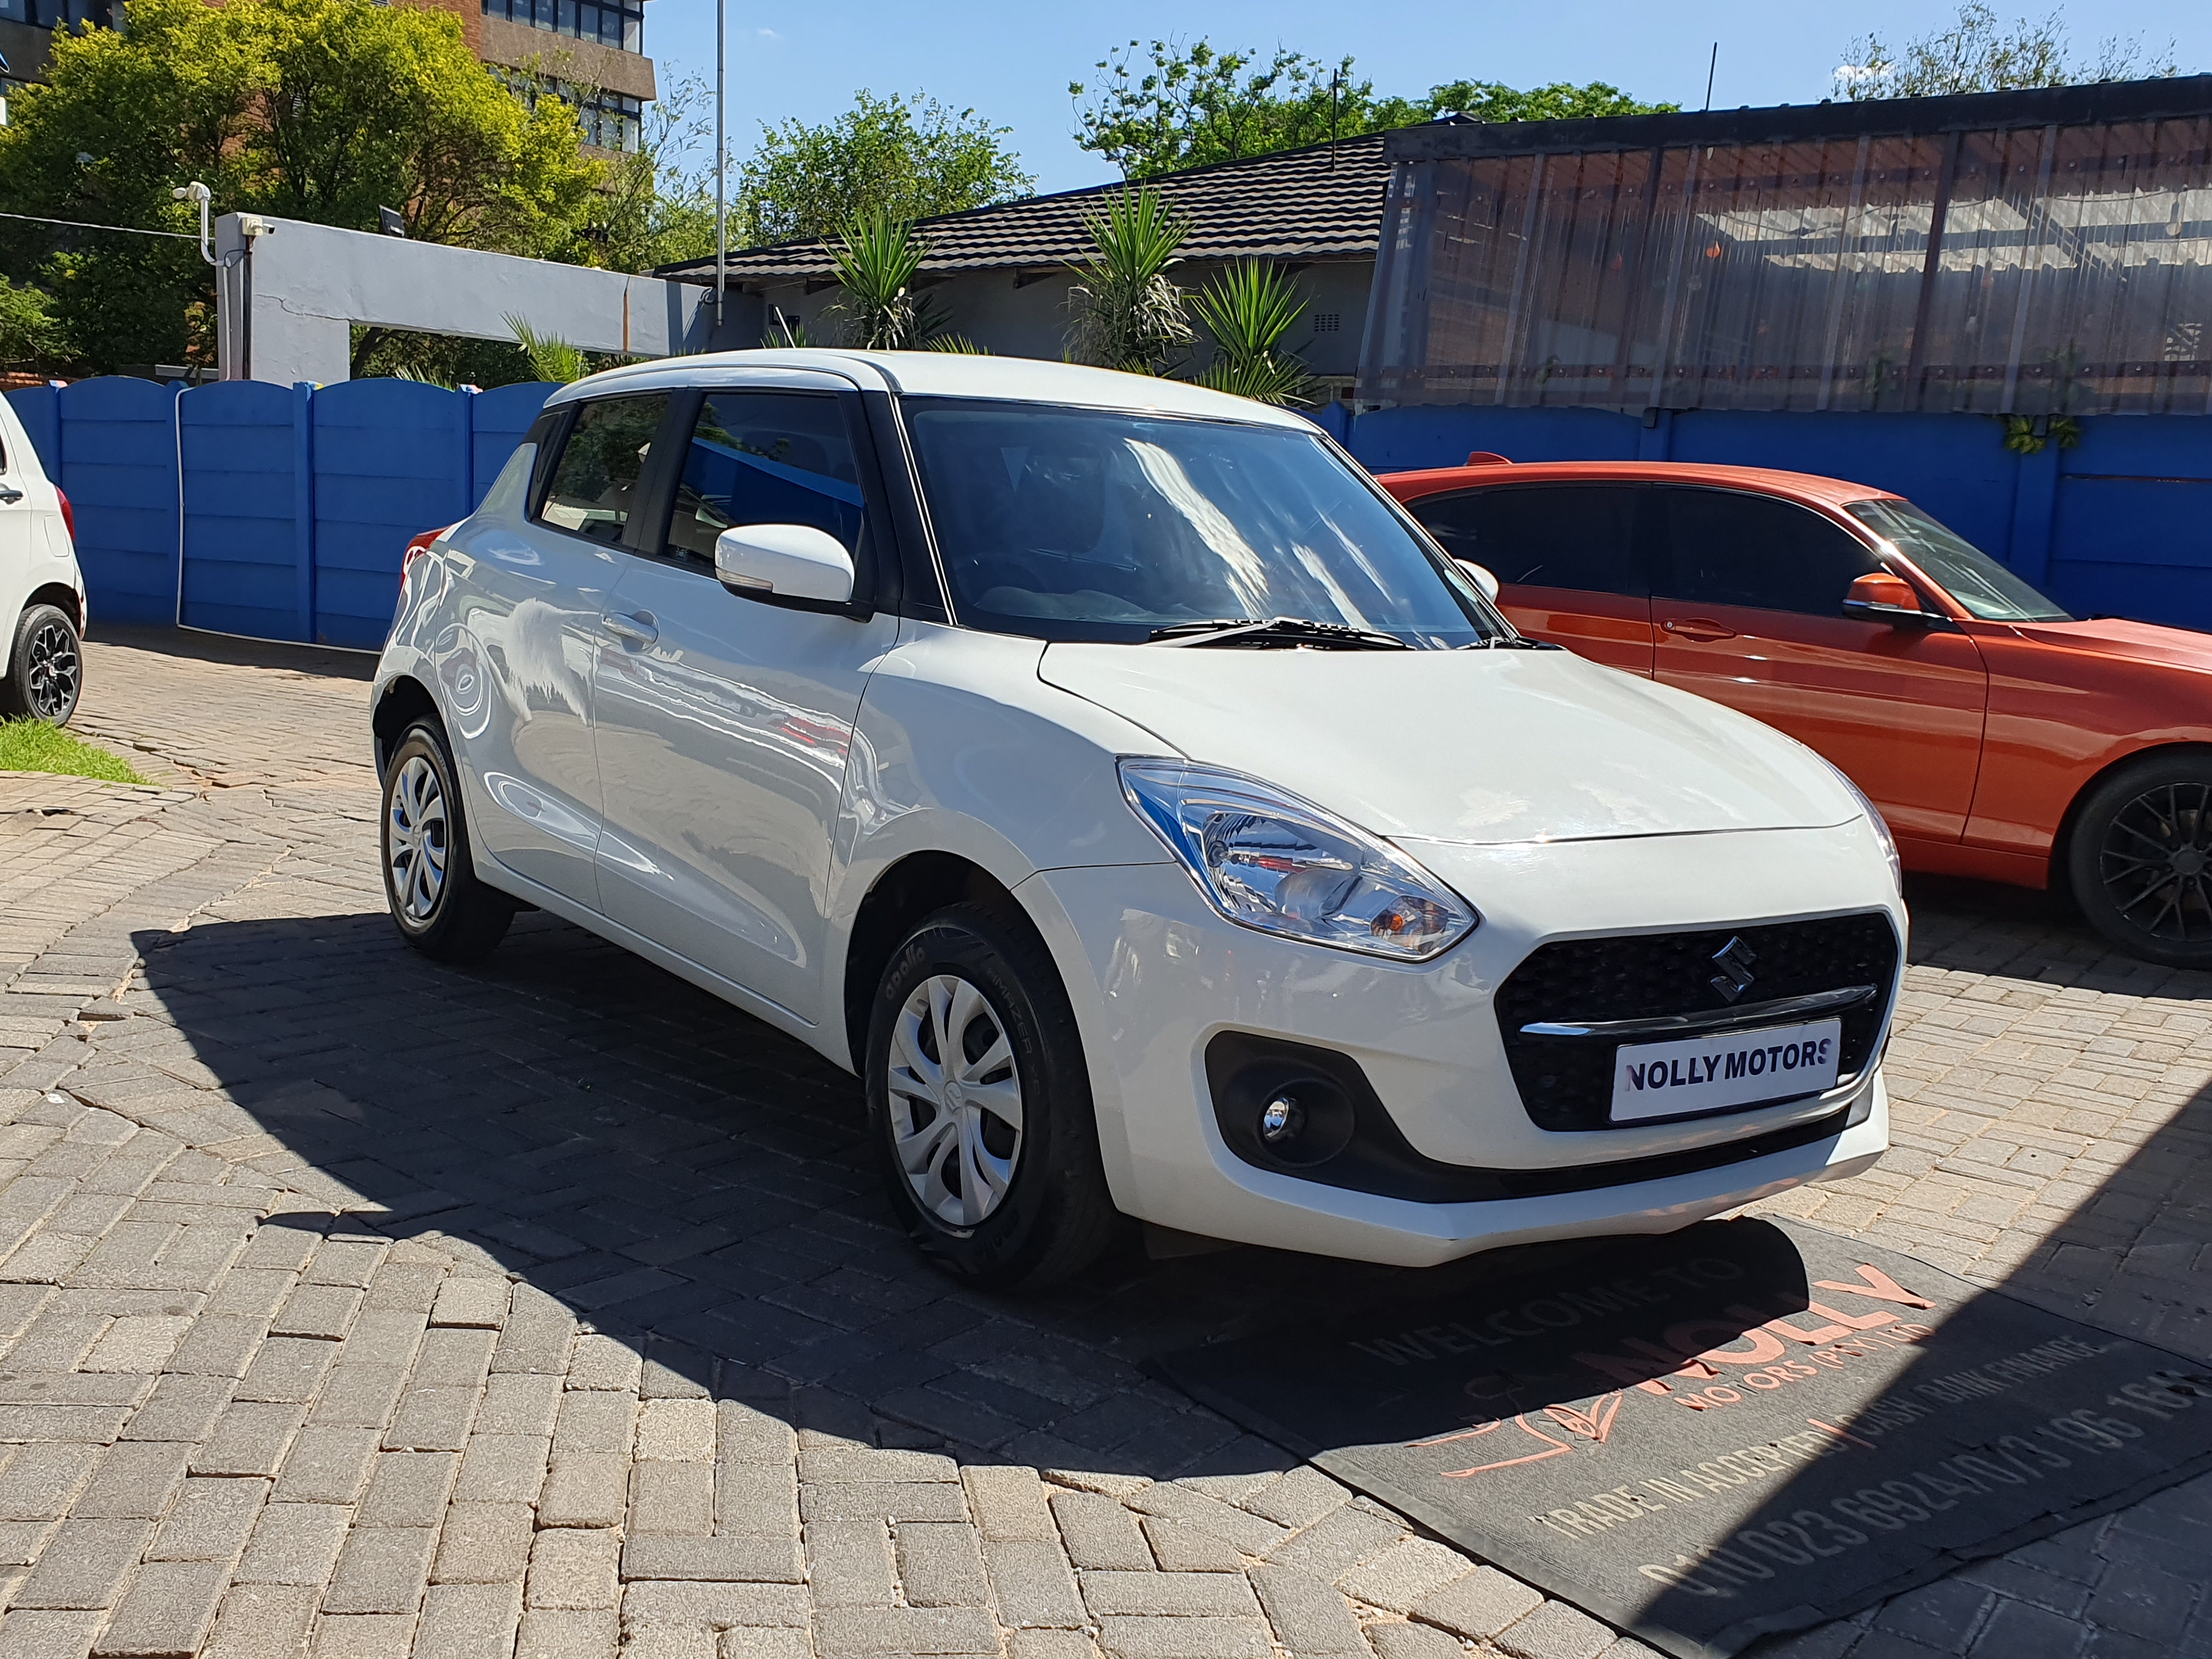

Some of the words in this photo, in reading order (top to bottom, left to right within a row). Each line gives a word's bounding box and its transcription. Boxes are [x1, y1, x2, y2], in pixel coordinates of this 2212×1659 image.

[885, 943, 926, 1001] apollo
[1625, 1054, 1722, 1092] NOLLY
[1724, 1038, 1832, 1079] MOTORS
[1347, 1277, 1672, 1365] WELCOME
[1650, 1257, 1746, 1289] TO
[1571, 1262, 1937, 1396] NOLLY
[1526, 1484, 1668, 1540] TRADE
[1638, 1476, 1705, 1504] IN
[1679, 1431, 1850, 1494] ACCEPTED
[1835, 1395, 1936, 1436] CASH
[1736, 1509, 1870, 1566] 023
[2034, 1408, 2145, 1455] 196
